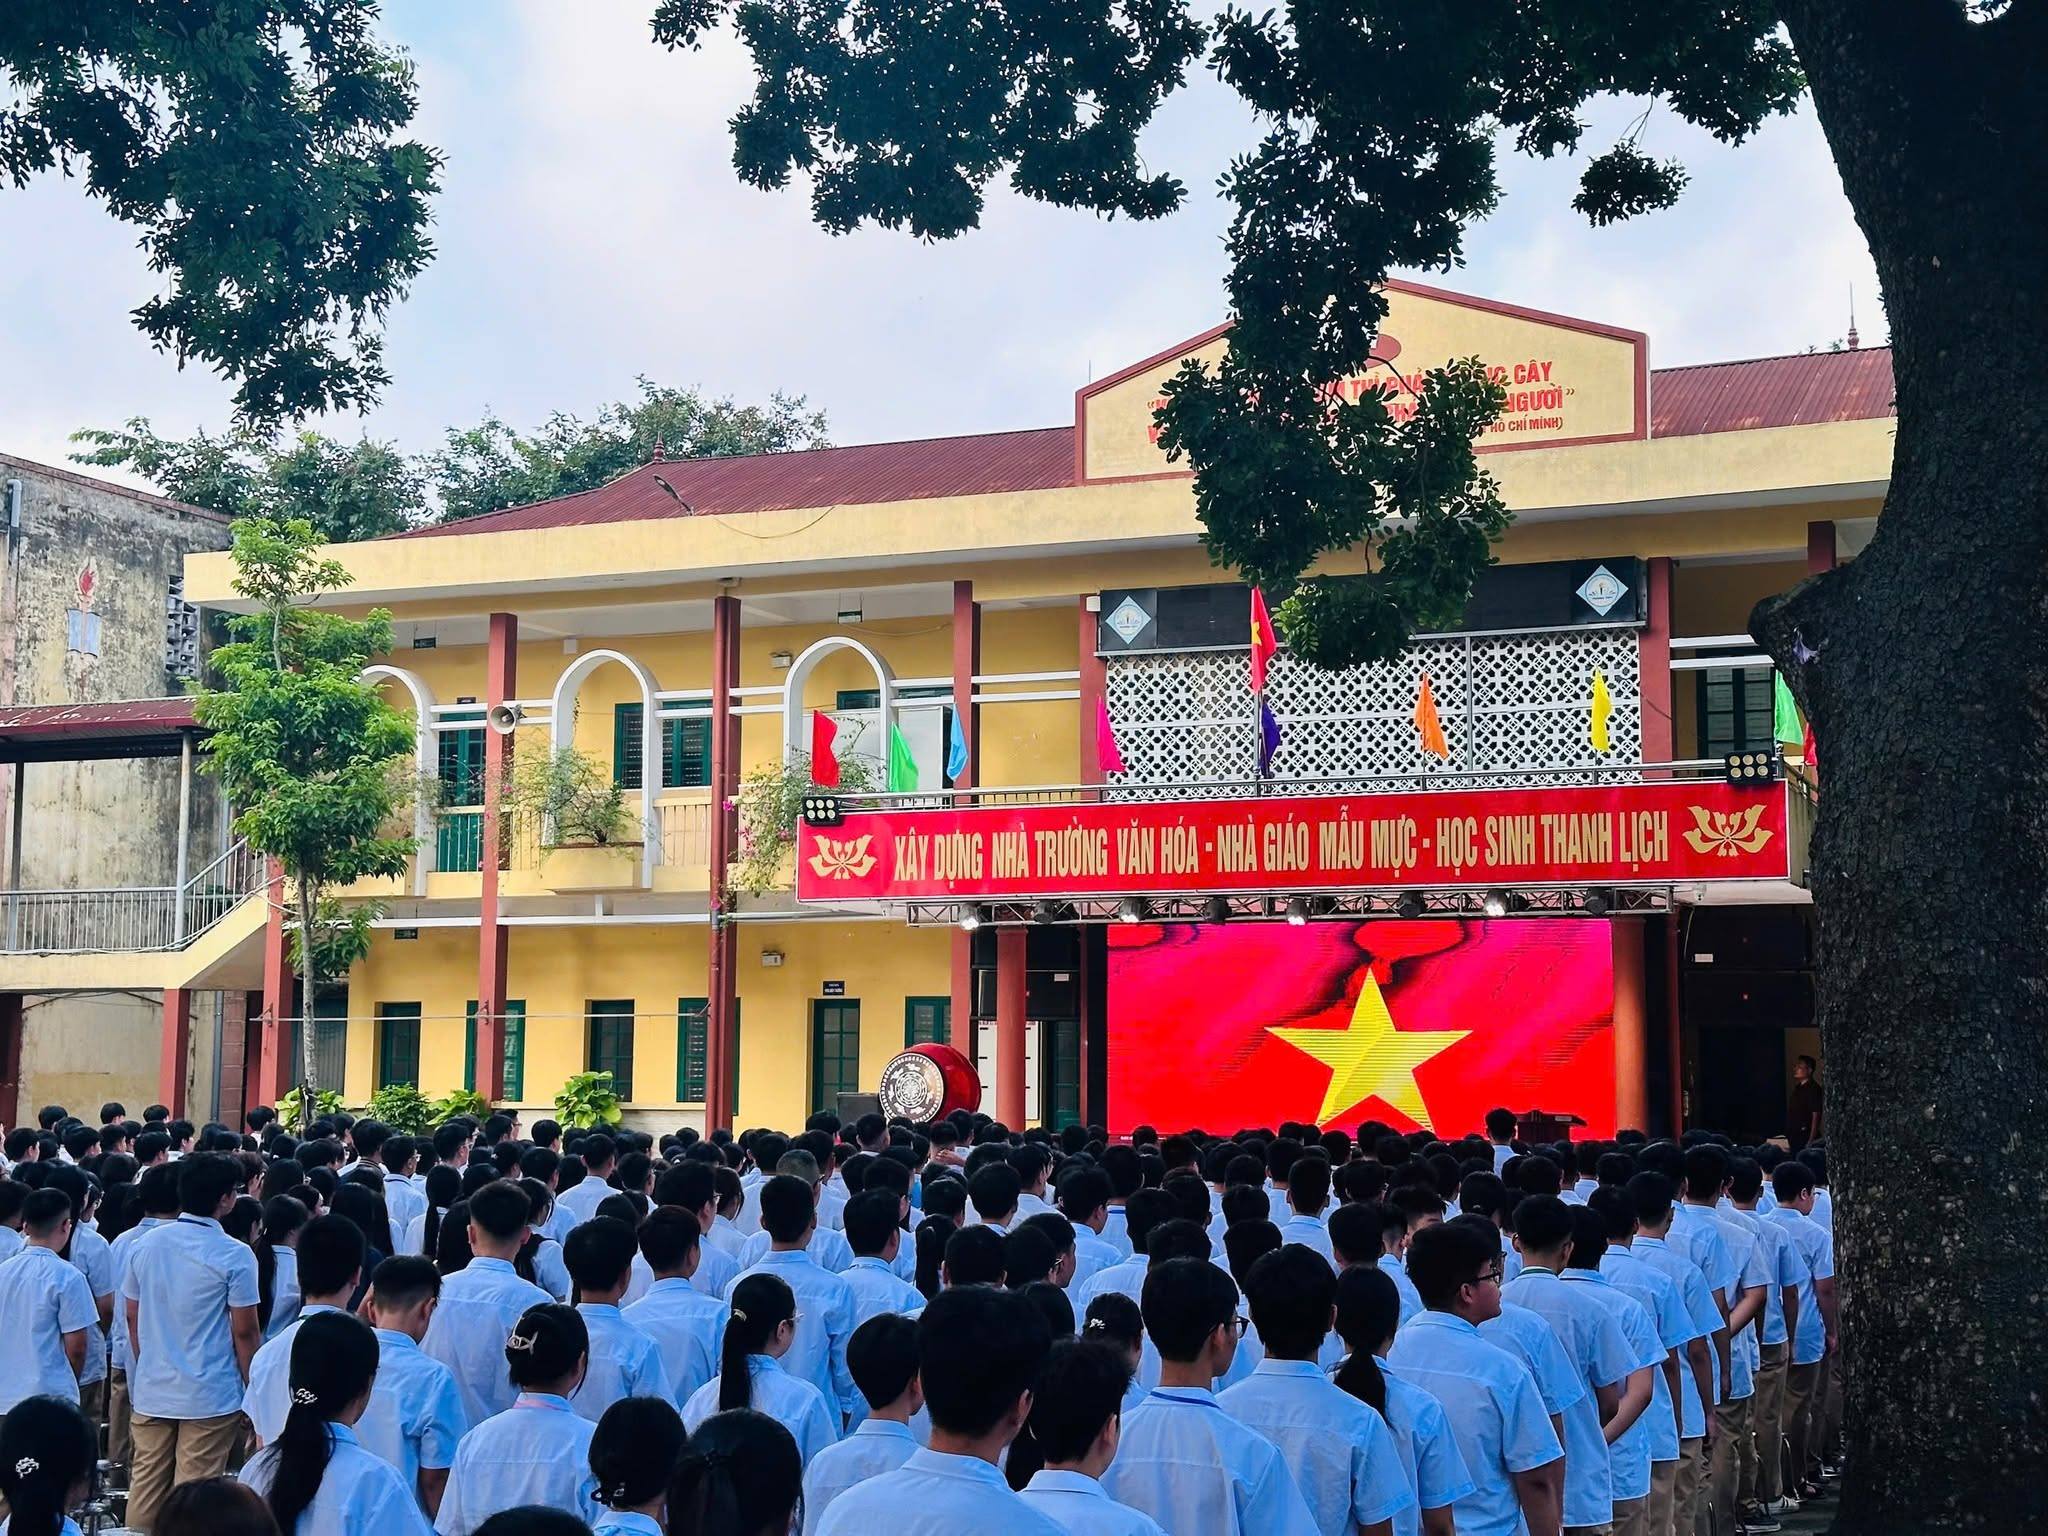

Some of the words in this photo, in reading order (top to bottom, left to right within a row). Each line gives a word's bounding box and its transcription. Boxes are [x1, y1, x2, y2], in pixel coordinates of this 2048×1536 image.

[1514, 359, 1552, 385] CÂY
[1508, 414, 1527, 431] CHÍ
[894, 826, 929, 881] XÂY
[934, 829, 983, 889] DỰNG
[992, 822, 1029, 878] NHÀ
[1034, 816, 1108, 878] TRƯỜNG
[1117, 818, 1155, 875] VĂN
[1161, 816, 1199, 874] HÓA
[1217, 814, 1258, 872] NHÀ
[1263, 812, 1309, 872] GIÁO
[1319, 804, 1364, 870] MẪU
[1371, 814, 1417, 878] MỰC
[1436, 816, 1478, 877] HỌC
[1484, 815, 1535, 867] SINH
[1540, 812, 1613, 864] THANH
[1619, 810, 1669, 872] LỊCH
